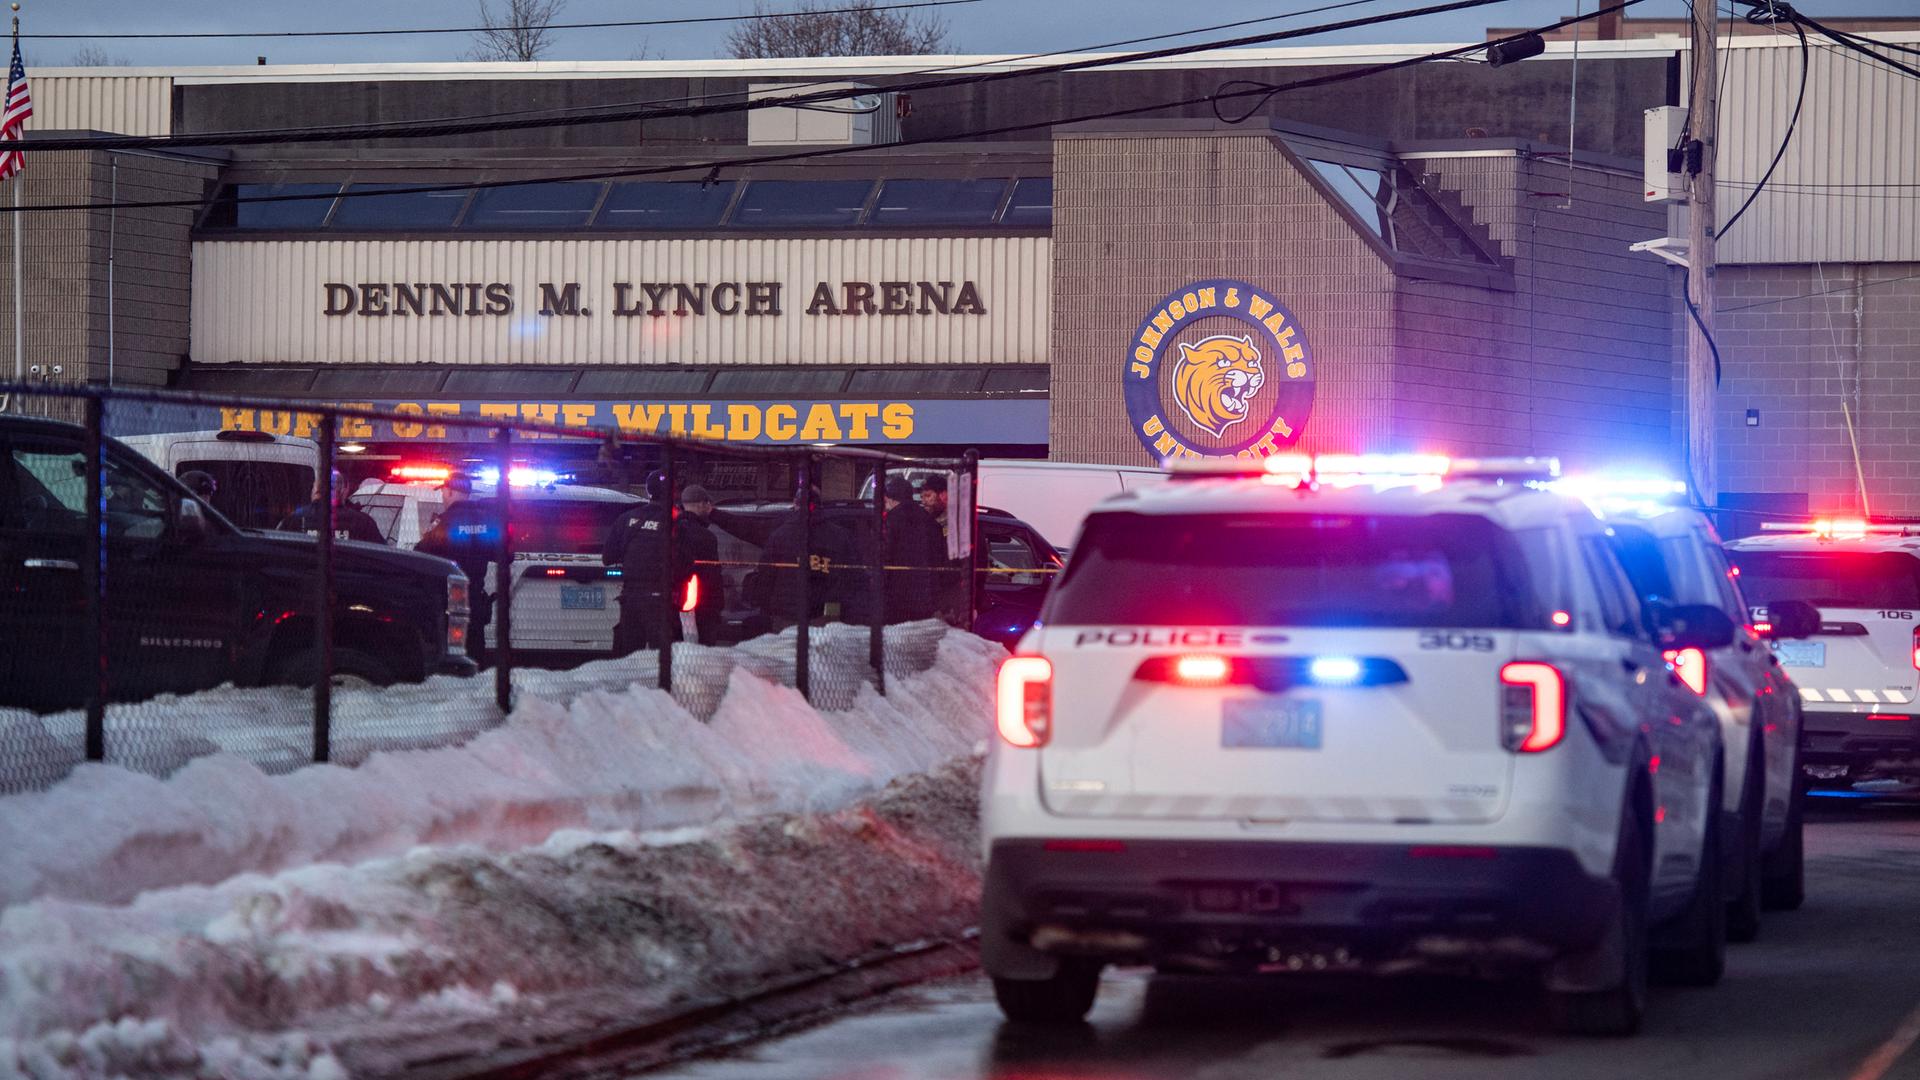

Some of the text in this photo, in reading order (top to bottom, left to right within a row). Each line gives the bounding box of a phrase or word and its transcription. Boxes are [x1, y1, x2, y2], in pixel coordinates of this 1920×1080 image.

[323, 281, 987, 317] DENNIS M. LYNCH ARENA
[1131, 287, 1308, 380] JOHNSON & WALES
[392, 403, 460, 439] OF
[480, 403, 596, 440] THE
[614, 403, 915, 441] WILDCATS
[1142, 415, 1294, 460] UNIVSITY
[458, 524, 488, 535] POLICE
[514, 552, 574, 562] OLICE
[809, 554, 831, 574] BI
[1876, 610, 1913, 620] 106
[140, 637, 223, 648] SILVERADO
[1075, 630, 1496, 652] POLICE 309
